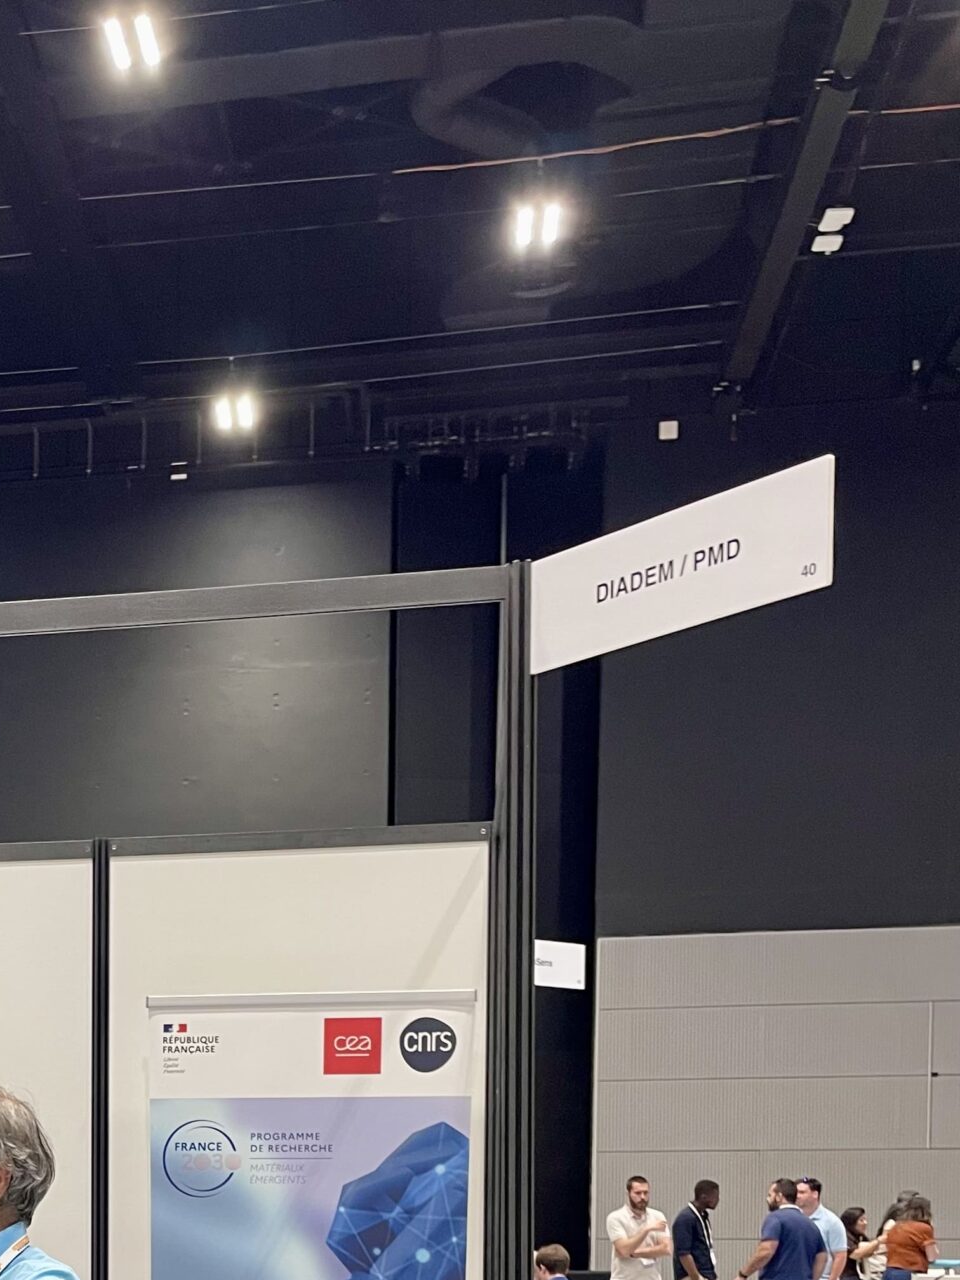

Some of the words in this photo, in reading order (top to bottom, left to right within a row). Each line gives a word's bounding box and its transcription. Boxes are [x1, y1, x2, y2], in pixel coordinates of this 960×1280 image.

[596, 560, 674, 603] DIADEM
[679, 554, 688, 577] /
[693, 538, 741, 571] PMD
[801, 562, 817, 577] 40
[162, 1035, 220, 1045] RÉPUBLIQUE
[334, 1035, 372, 1051] cea
[403, 1031, 453, 1052] cnrs
[162, 1045, 216, 1054] FRANÇAISE
[250, 1132, 321, 1141] PROGRAMME
[175, 1142, 222, 1151] FRANCE
[250, 1144, 263, 1153] DE
[268, 1144, 333, 1153] RECHERCHE
[250, 1162, 305, 1173] MATÉRIAUX
[250, 1174, 307, 1185] ÉMERGENTS
